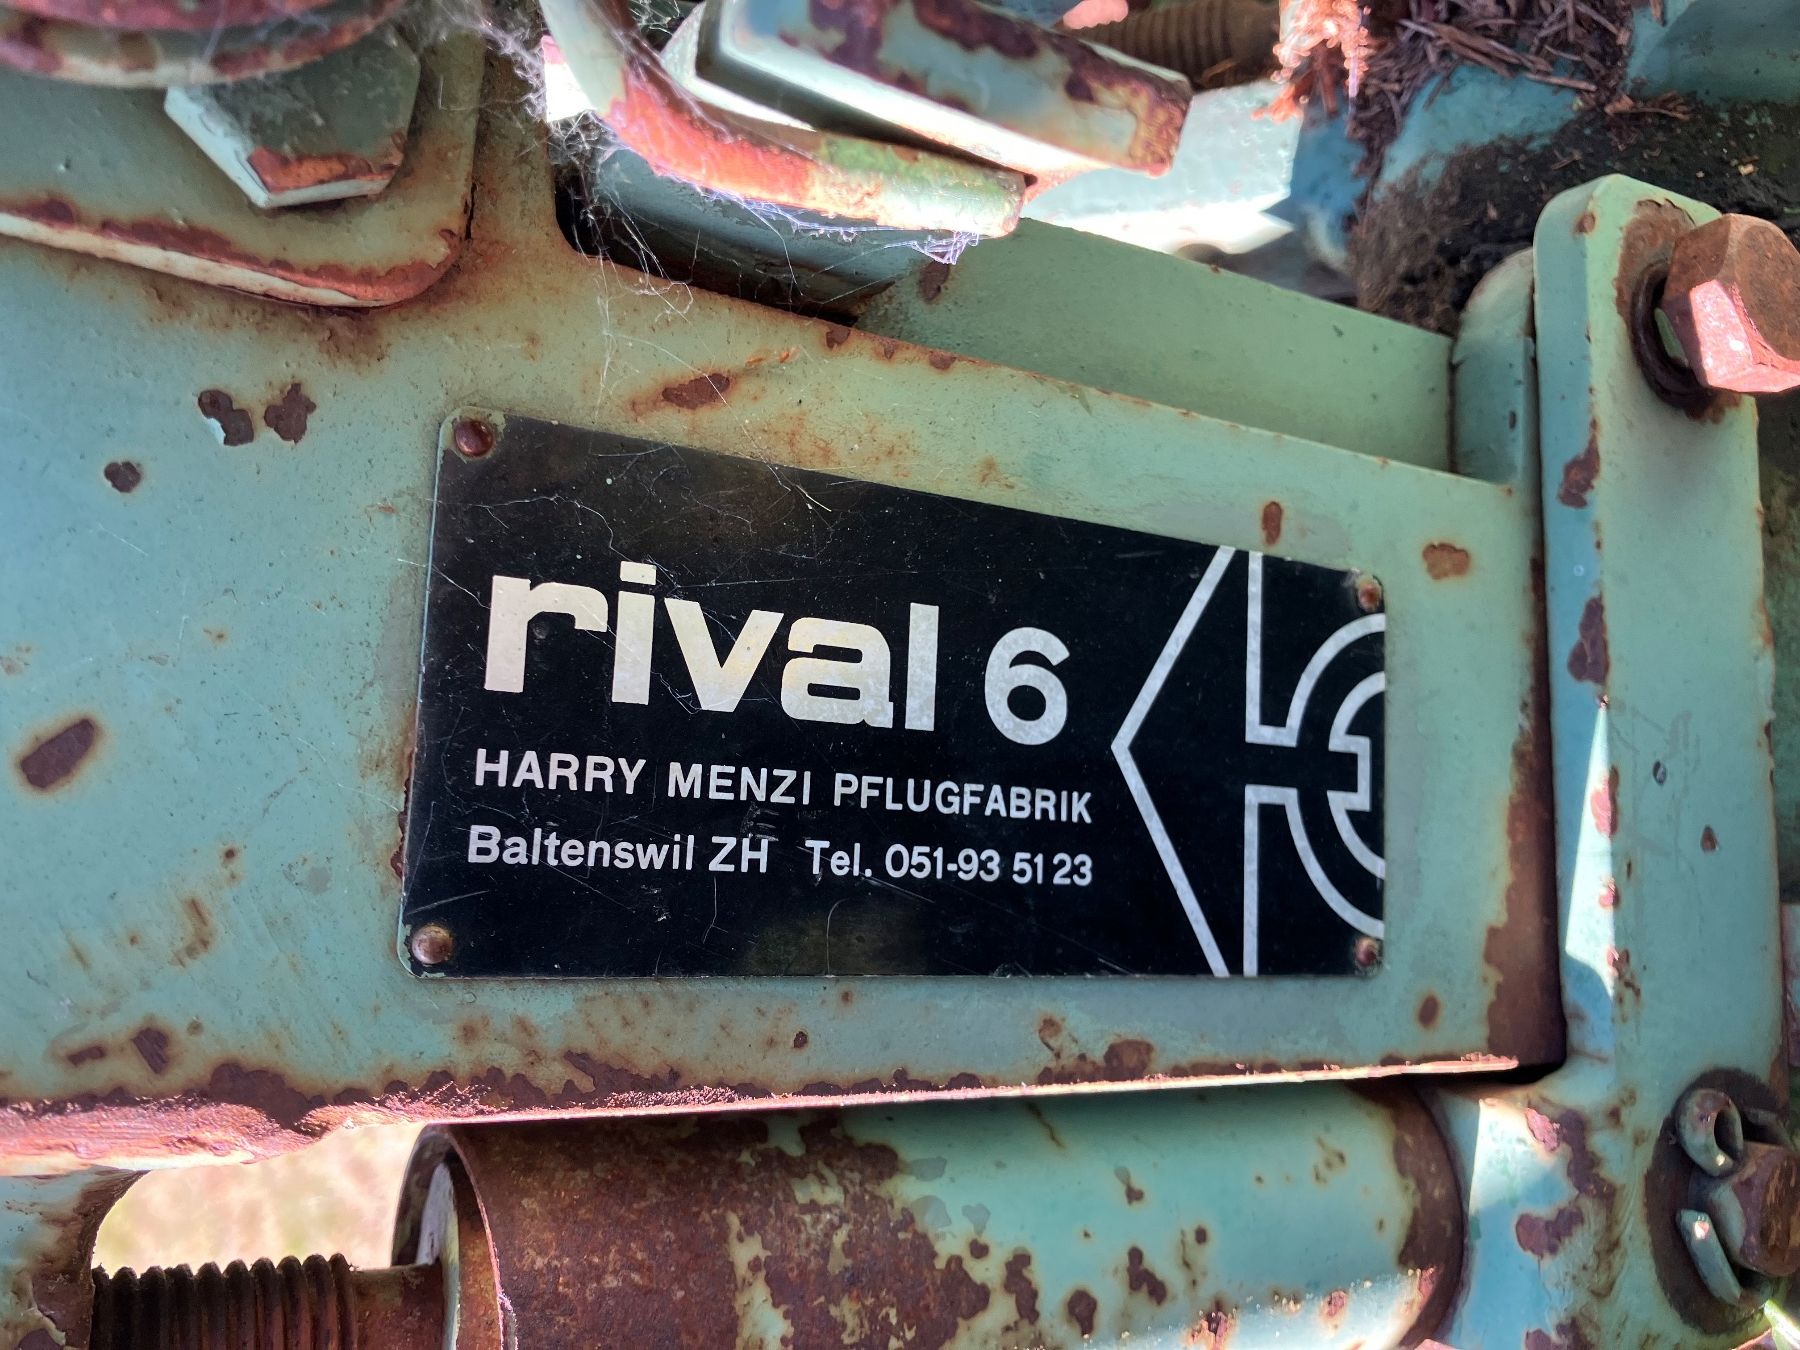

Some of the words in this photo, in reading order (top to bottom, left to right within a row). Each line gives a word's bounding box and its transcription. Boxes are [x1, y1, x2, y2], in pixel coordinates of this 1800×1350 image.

[484, 561, 939, 731] rival
[985, 627, 1069, 745] 6
[475, 748, 647, 795] HARRY
[667, 761, 811, 805] MENZI
[833, 772, 1092, 824] PFLUGFABRIK
[467, 824, 695, 871] Baltenswil
[708, 833, 769, 873] ZH
[805, 839, 873, 878] Tel.
